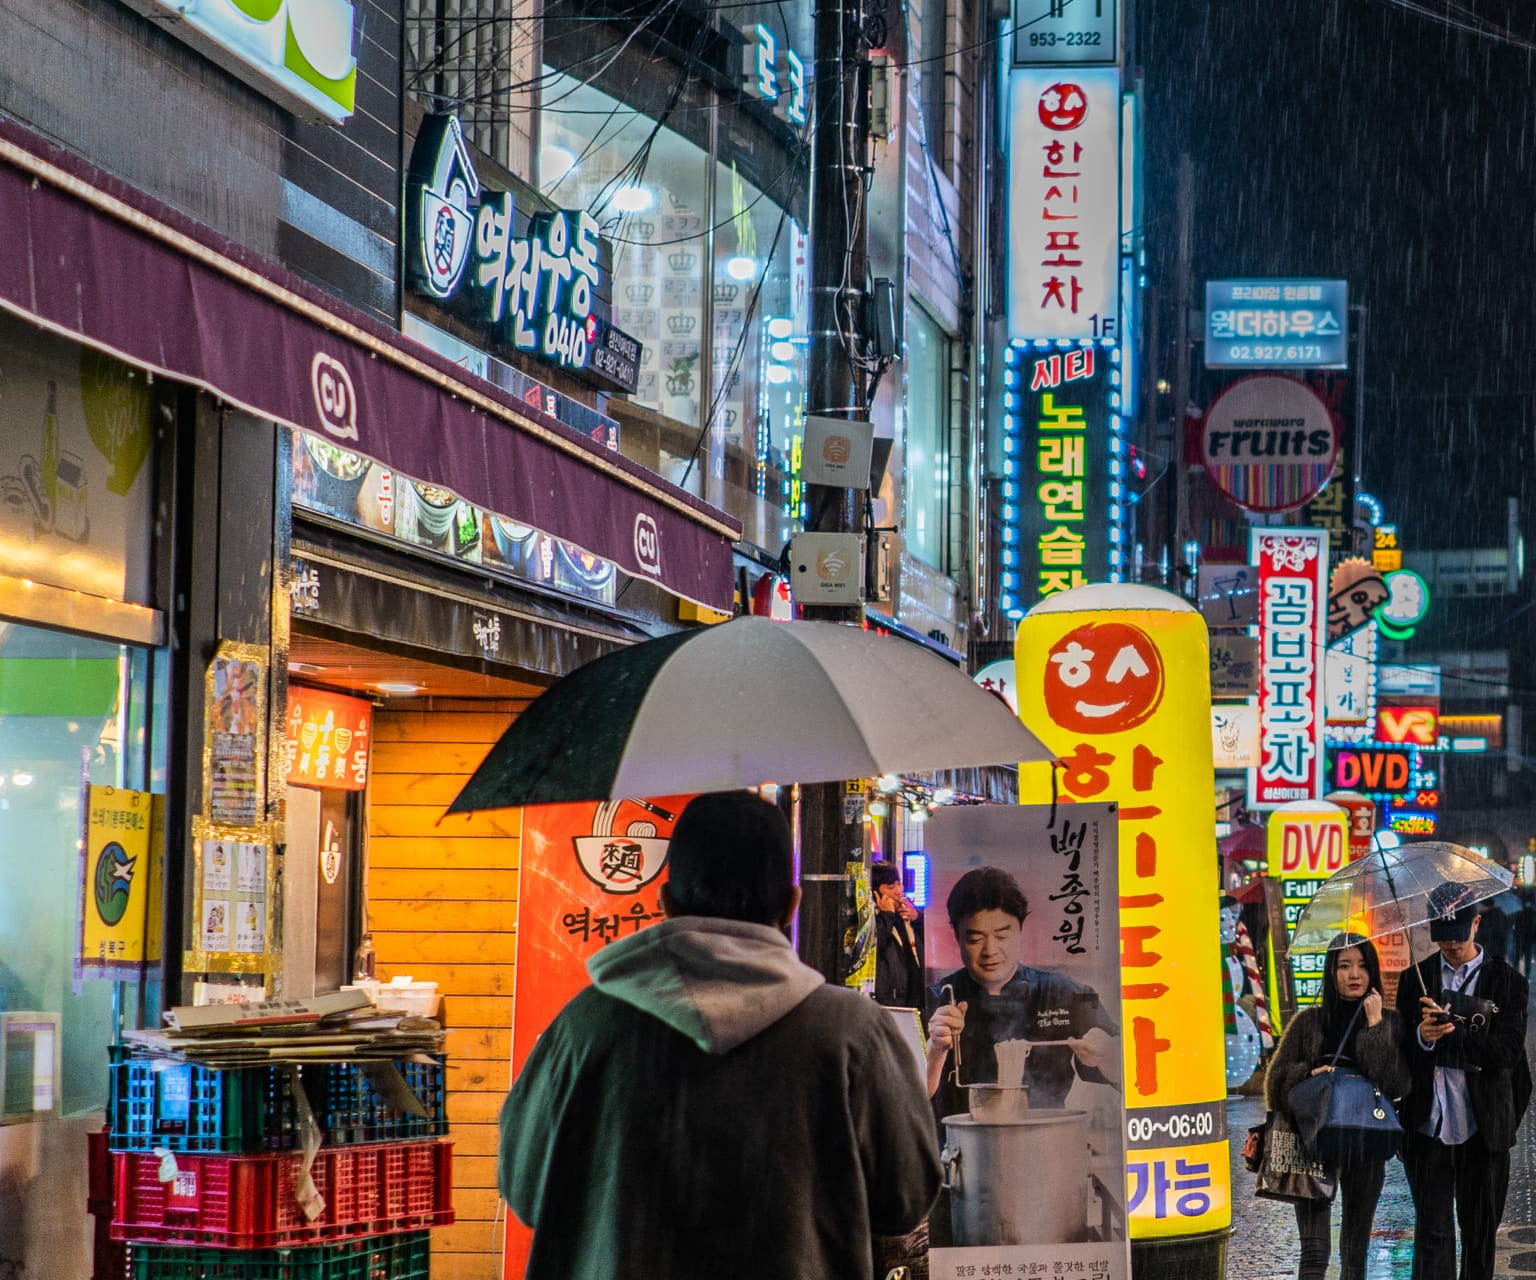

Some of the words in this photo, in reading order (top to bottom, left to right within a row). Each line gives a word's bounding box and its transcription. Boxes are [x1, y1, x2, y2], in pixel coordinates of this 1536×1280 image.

[1029, 31, 1102, 48] 953-2322
[1040, 139, 1085, 315] 한신포차
[477, 191, 601, 347] 역전우동
[544, 312, 588, 369] 0410
[1088, 313, 1117, 340] 1F
[1209, 308, 1343, 340] 원더하우스
[594, 348, 635, 386] 02-921-0410
[1030, 347, 1096, 392] 시티
[1229, 344, 1323, 362] 02.927.6171
[319, 370, 349, 423] CU
[636, 525, 656, 560] CU
[1375, 533, 1397, 549] 24
[315, 709, 334, 779] 우동
[1378, 710, 1437, 743] VR
[1336, 751, 1409, 790] DVD
[1281, 823, 1344, 872] DVD
[1049, 819, 1091, 956] 백종원
[981, 1263, 1014, 1276] 담백한
[1016, 1262, 1049, 1275] 국물과
